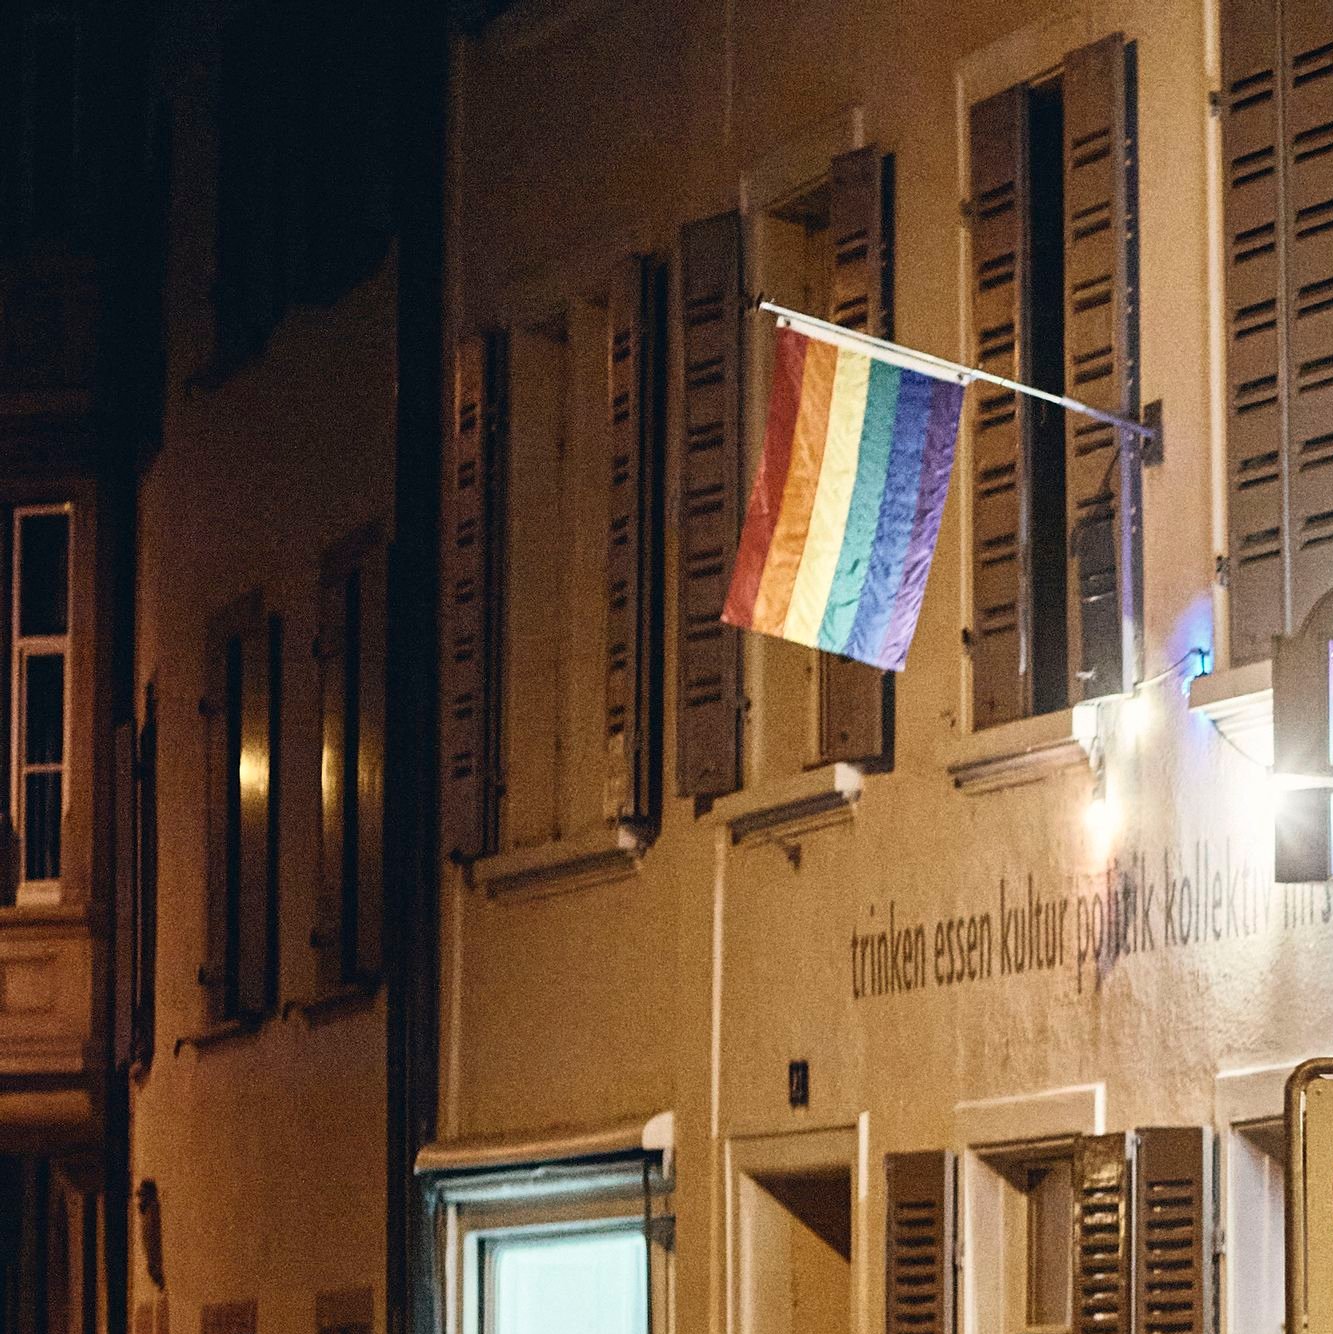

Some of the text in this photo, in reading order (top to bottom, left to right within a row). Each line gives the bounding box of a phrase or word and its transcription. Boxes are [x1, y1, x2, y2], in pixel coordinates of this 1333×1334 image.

[851, 900, 926, 1000] trinken
[933, 912, 993, 986] essen
[1000, 872, 1068, 976] kultur
[1076, 851, 1154, 994] politik
